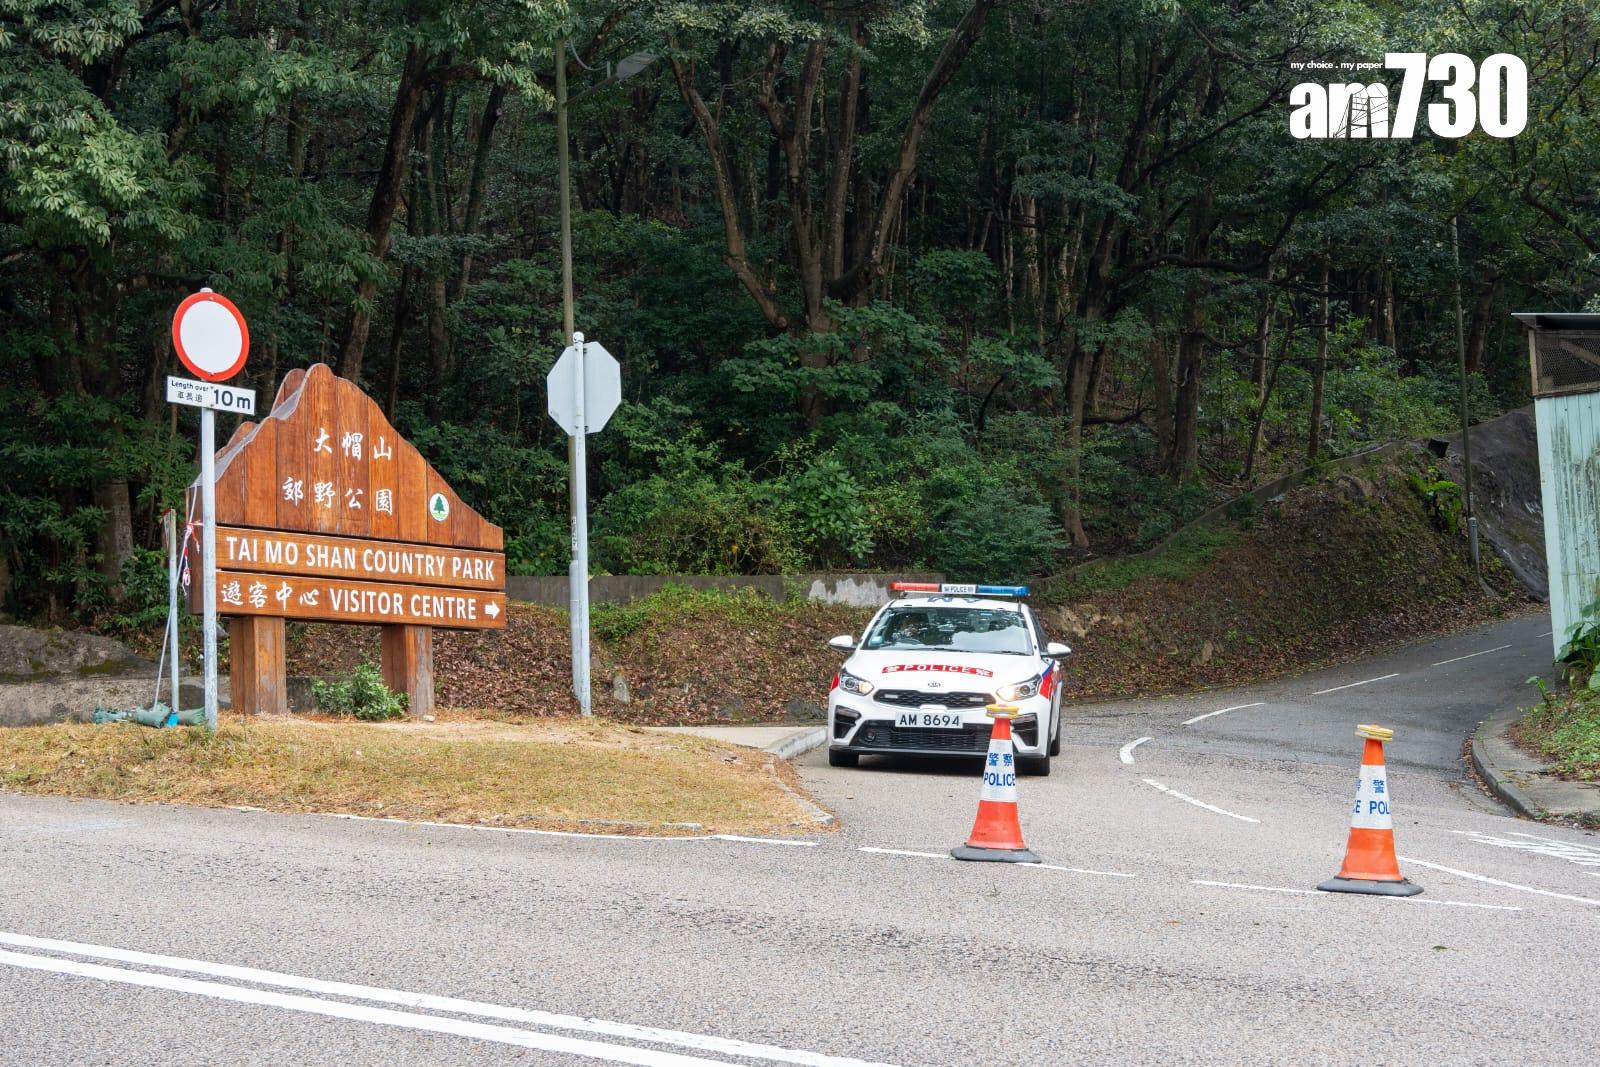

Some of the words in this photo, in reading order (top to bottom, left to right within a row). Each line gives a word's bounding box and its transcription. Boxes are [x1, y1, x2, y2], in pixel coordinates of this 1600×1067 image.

[171, 380, 194, 390] Length
[313, 427, 392, 461] 大帽山
[282, 476, 393, 516] 郊野公園
[226, 536, 258, 562] TAI
[265, 541, 299, 566] MO
[306, 544, 356, 571] SHAN
[363, 549, 445, 578] COUNTRY
[452, 556, 495, 581] PARK
[220, 580, 320, 611] 遊客中心
[330, 588, 404, 616] VISITOR
[410, 594, 477, 620] CENTRE
[903, 664, 969, 674] POLICE
[900, 714, 917, 726] AM
[923, 714, 960, 727] 8694
[983, 772, 1016, 787] POLICE
